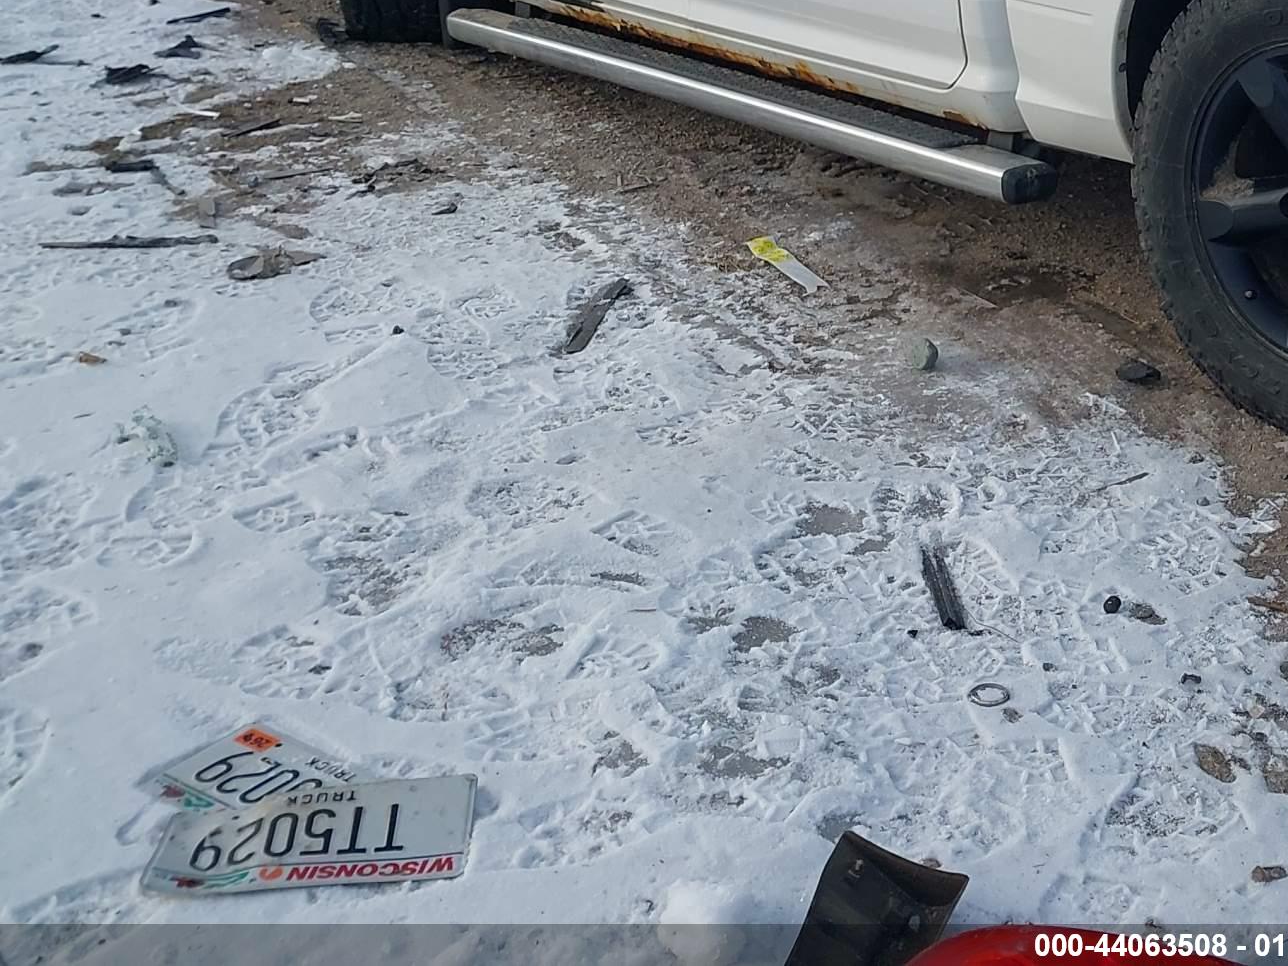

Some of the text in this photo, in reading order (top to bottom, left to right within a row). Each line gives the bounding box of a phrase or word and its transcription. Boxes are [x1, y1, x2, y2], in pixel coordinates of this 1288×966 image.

[306, 756, 357, 782] TRUCK
[288, 790, 357, 806] TRUCK
[189, 803, 404, 872] TT5029
[285, 856, 454, 882] WISCONSIN
